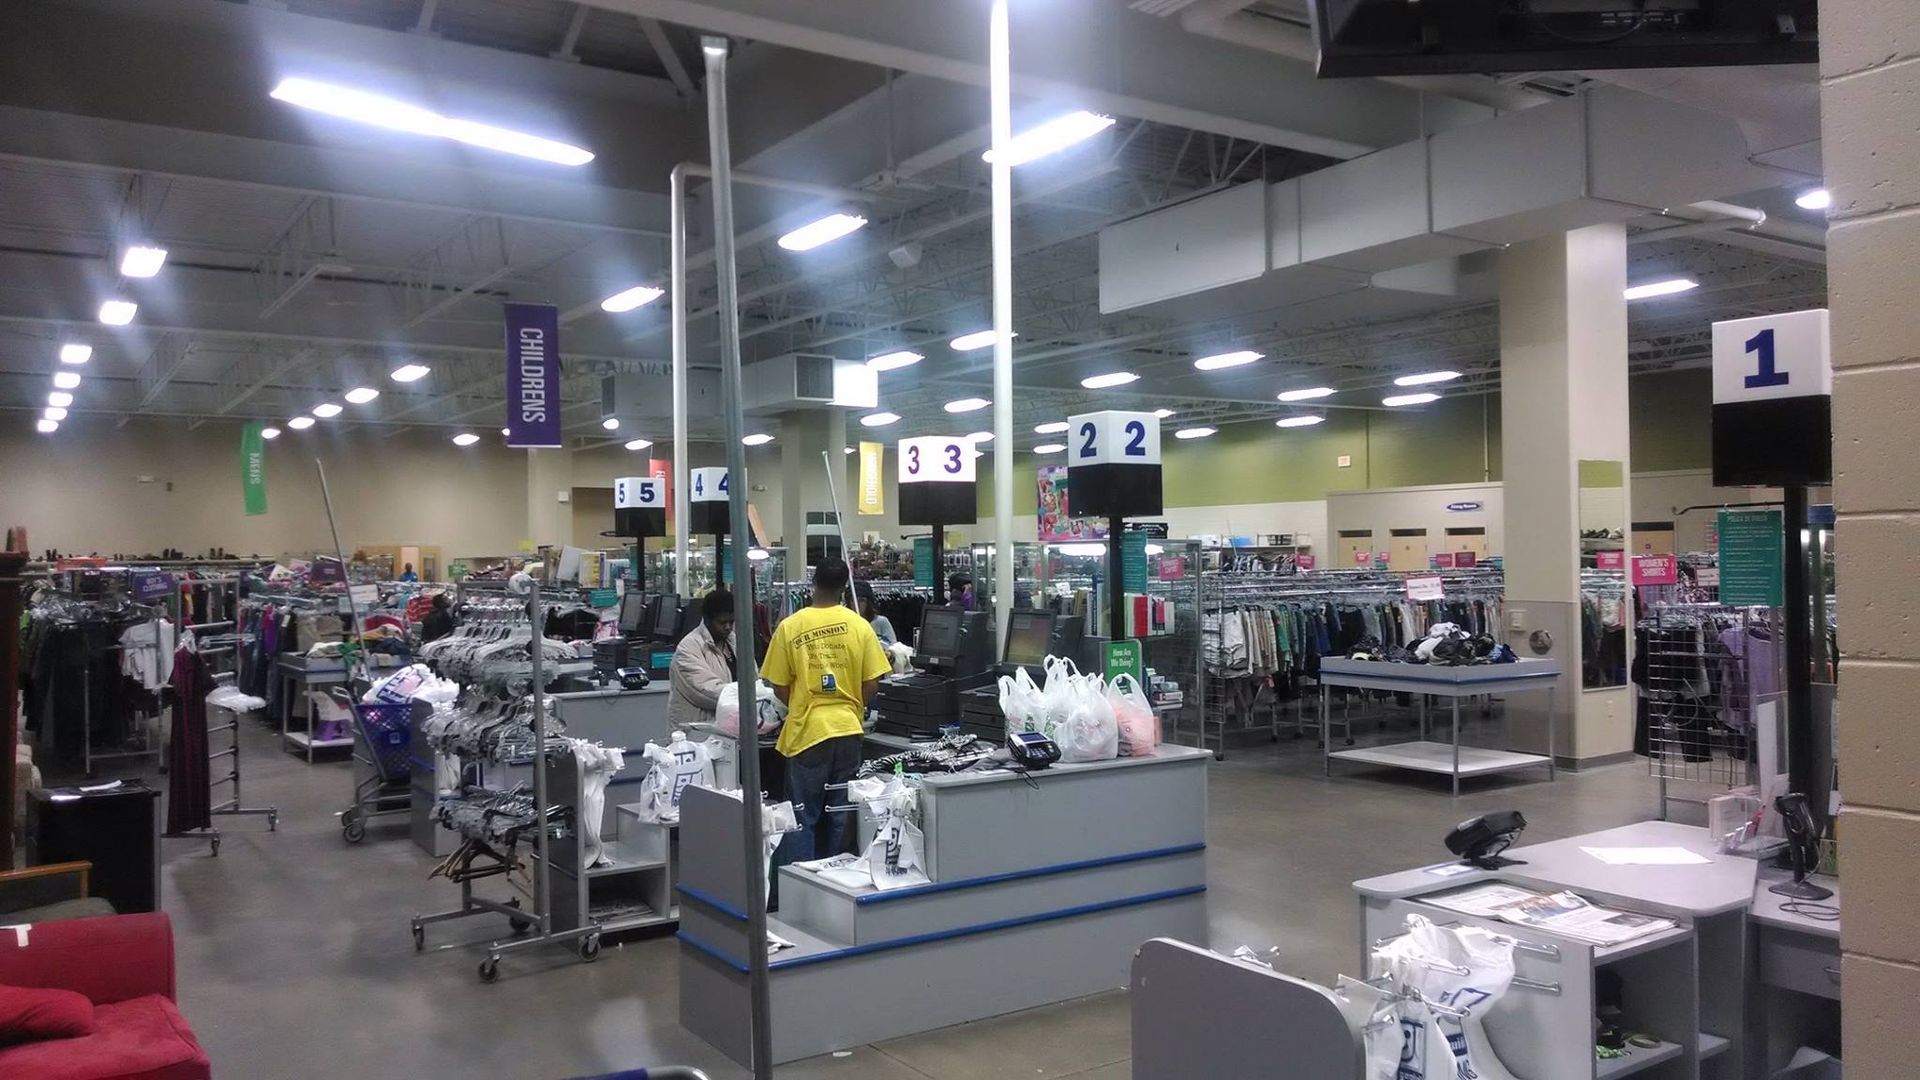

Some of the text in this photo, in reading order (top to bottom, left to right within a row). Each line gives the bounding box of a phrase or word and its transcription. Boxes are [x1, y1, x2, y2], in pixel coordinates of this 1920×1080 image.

[1744, 328, 1790, 389] 1
[520, 328, 546, 422] CHILDRENS
[1080, 422, 1097, 458] 2
[1125, 420, 1146, 456] 2
[249, 452, 261, 485] MENS
[908, 445, 920, 475] 3
[944, 444, 962, 474] 3
[619, 483, 625, 503] 5
[640, 482, 655, 503] 5
[695, 473, 703, 496] 4
[795, 626, 845, 645] OUR MISSION
